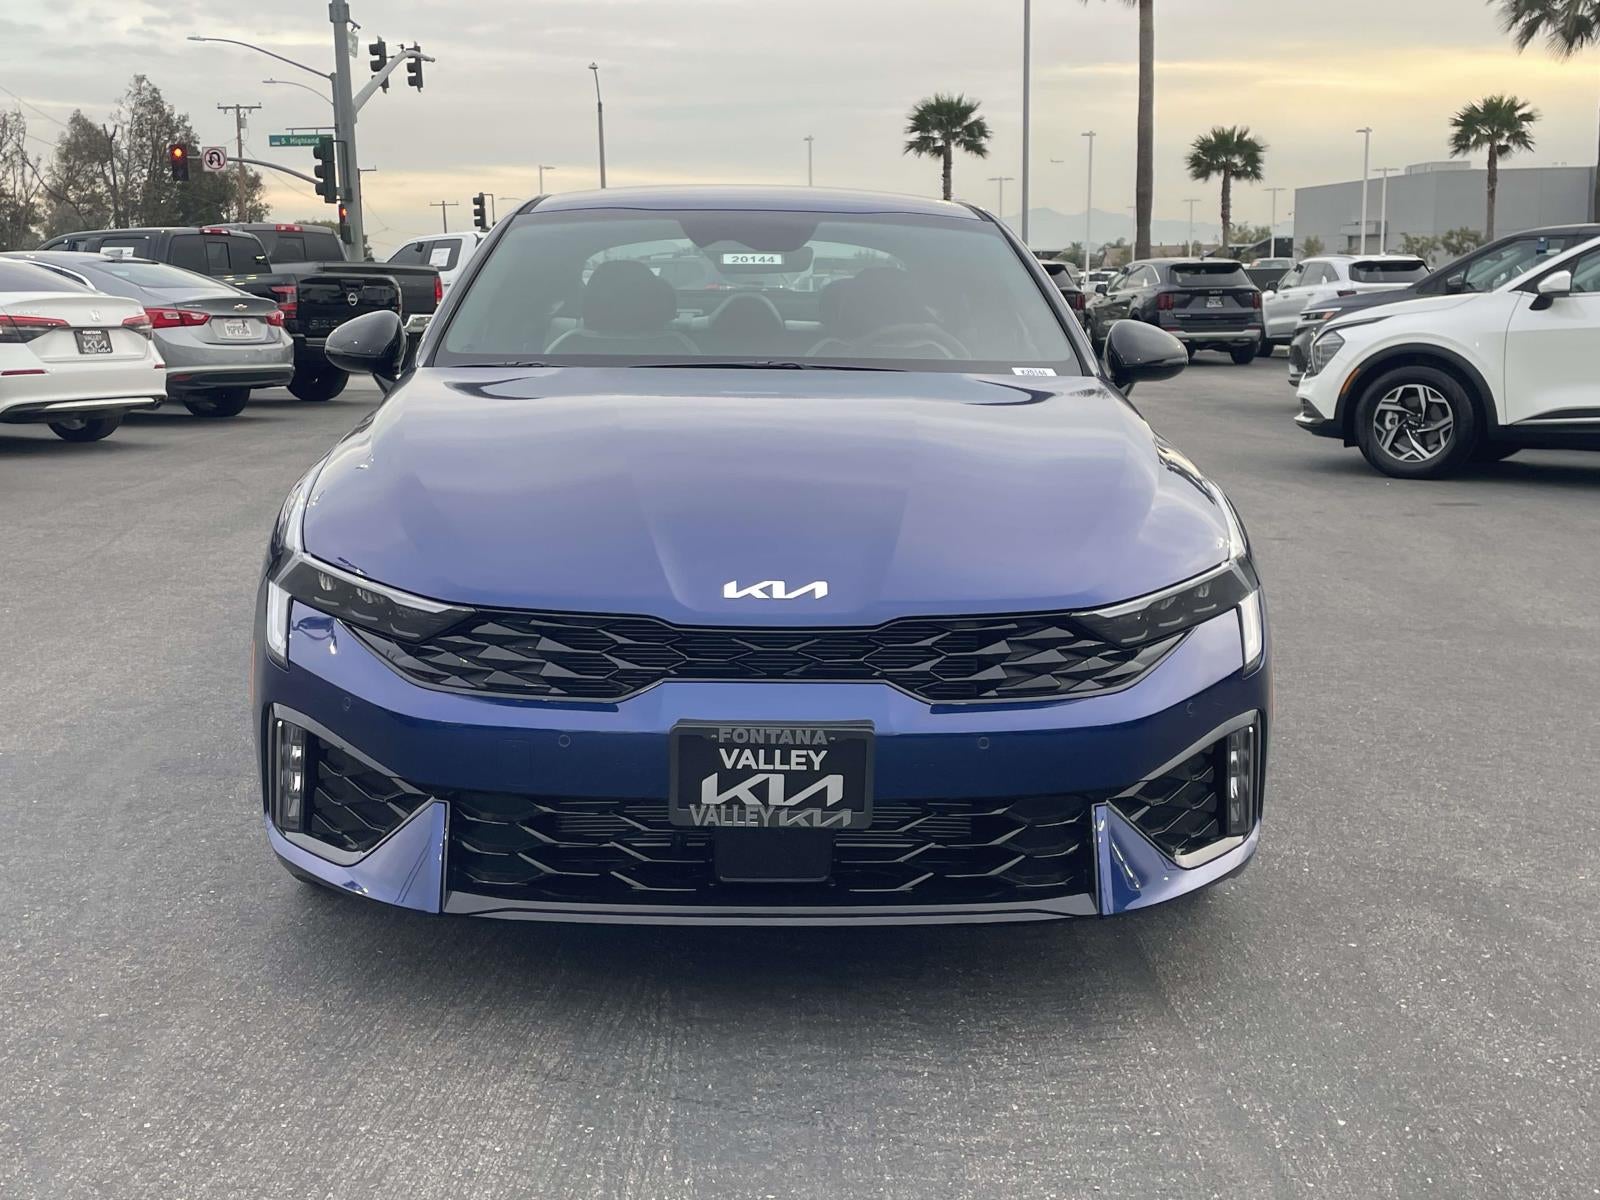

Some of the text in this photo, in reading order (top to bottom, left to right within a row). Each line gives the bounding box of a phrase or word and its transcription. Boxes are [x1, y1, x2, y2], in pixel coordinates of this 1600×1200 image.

[731, 255, 776, 263] 20144
[723, 580, 828, 600] KIA
[718, 727, 828, 745] FONTANA
[719, 748, 828, 770] VALLEY
[701, 772, 844, 807] KIA
[689, 804, 852, 828] VALLEY KIA
